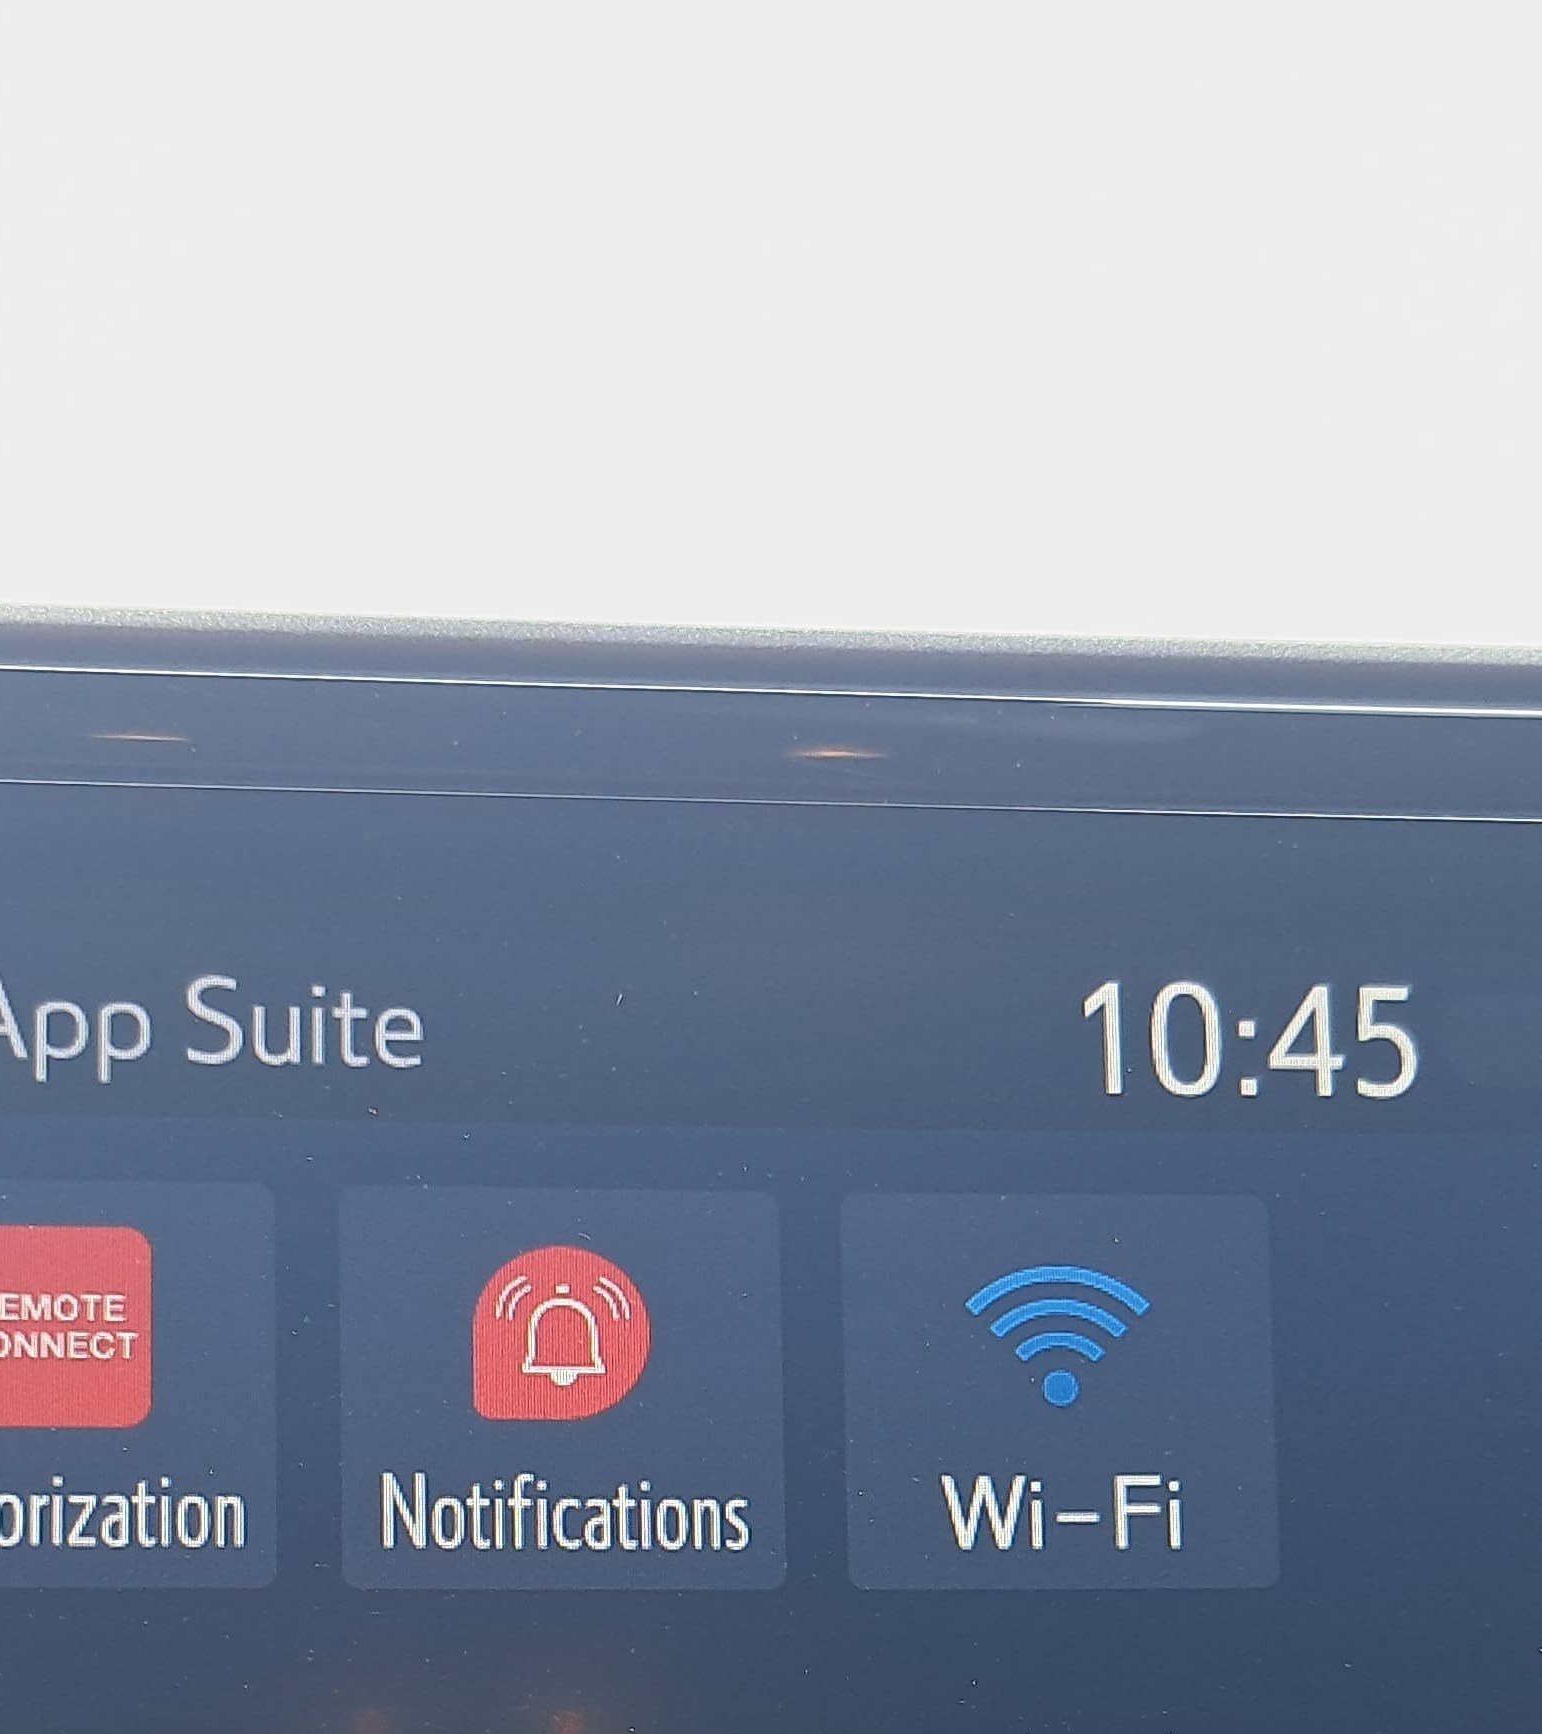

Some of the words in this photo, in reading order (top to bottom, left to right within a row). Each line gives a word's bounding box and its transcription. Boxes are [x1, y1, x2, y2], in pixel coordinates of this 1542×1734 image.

[187, 975, 421, 1067] Suite
[1085, 981, 1417, 1097] 10:45
[383, 1473, 748, 1550] Notifications
[942, 1476, 1180, 1549] Wi-Fi
